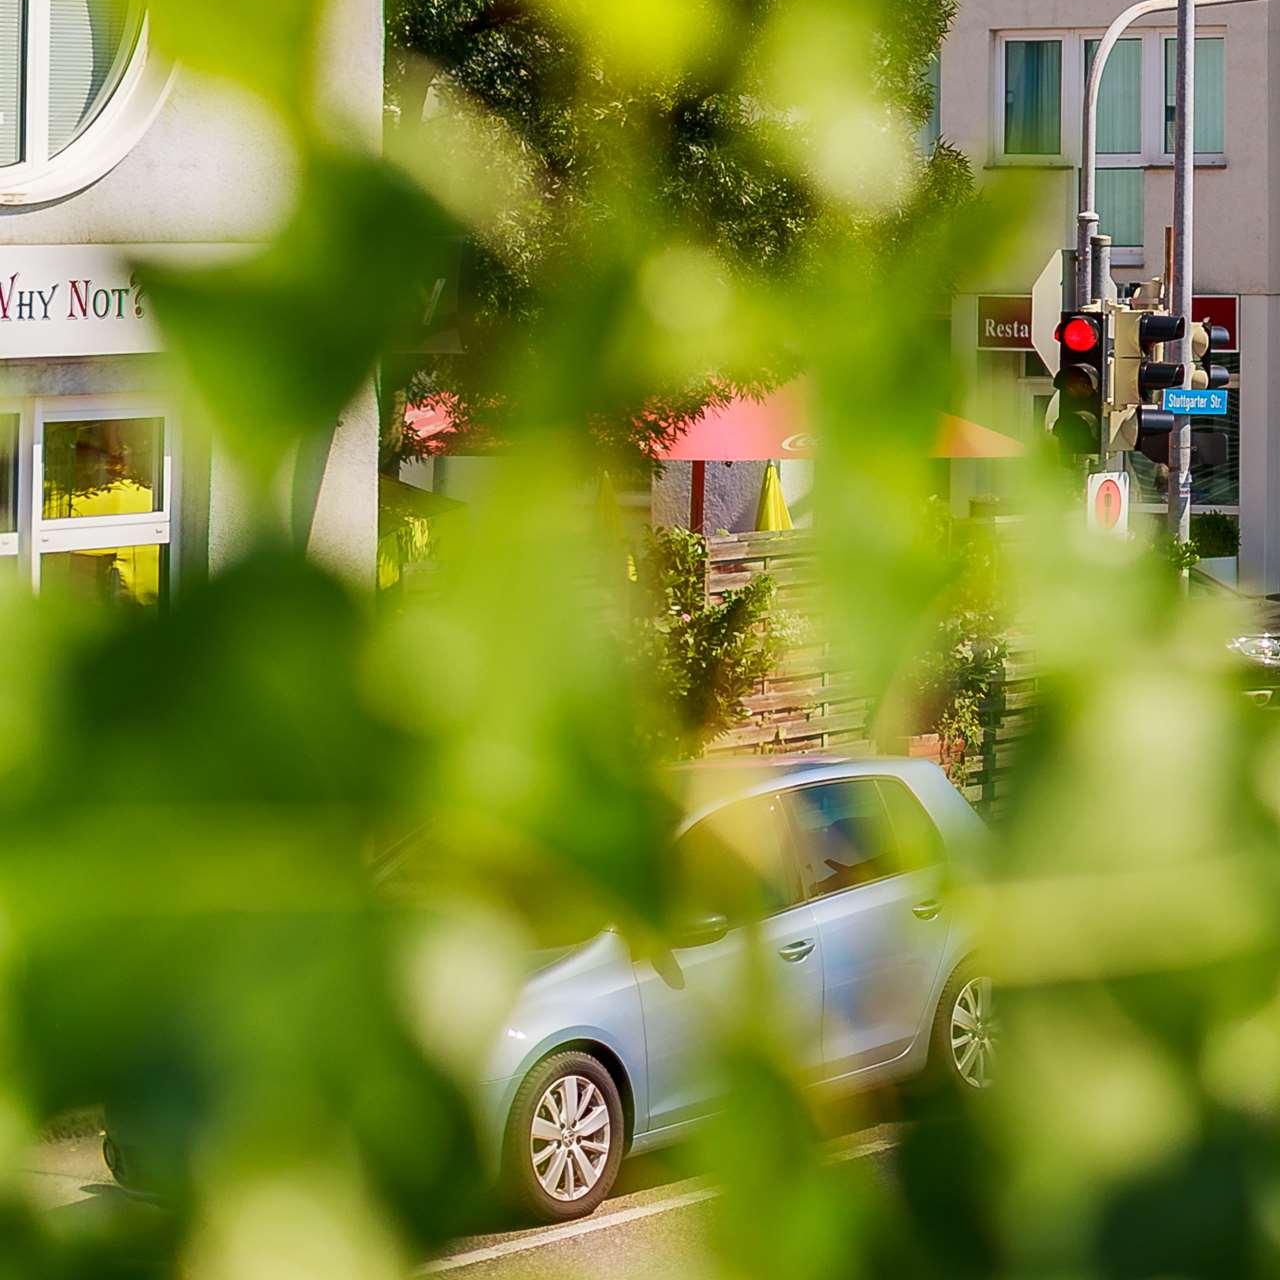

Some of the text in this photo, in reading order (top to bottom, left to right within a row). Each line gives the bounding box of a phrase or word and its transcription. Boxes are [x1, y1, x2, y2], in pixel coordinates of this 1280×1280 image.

[985, 318, 1030, 338] Resta
[1168, 392, 1222, 412] Stuttgarter Str.
